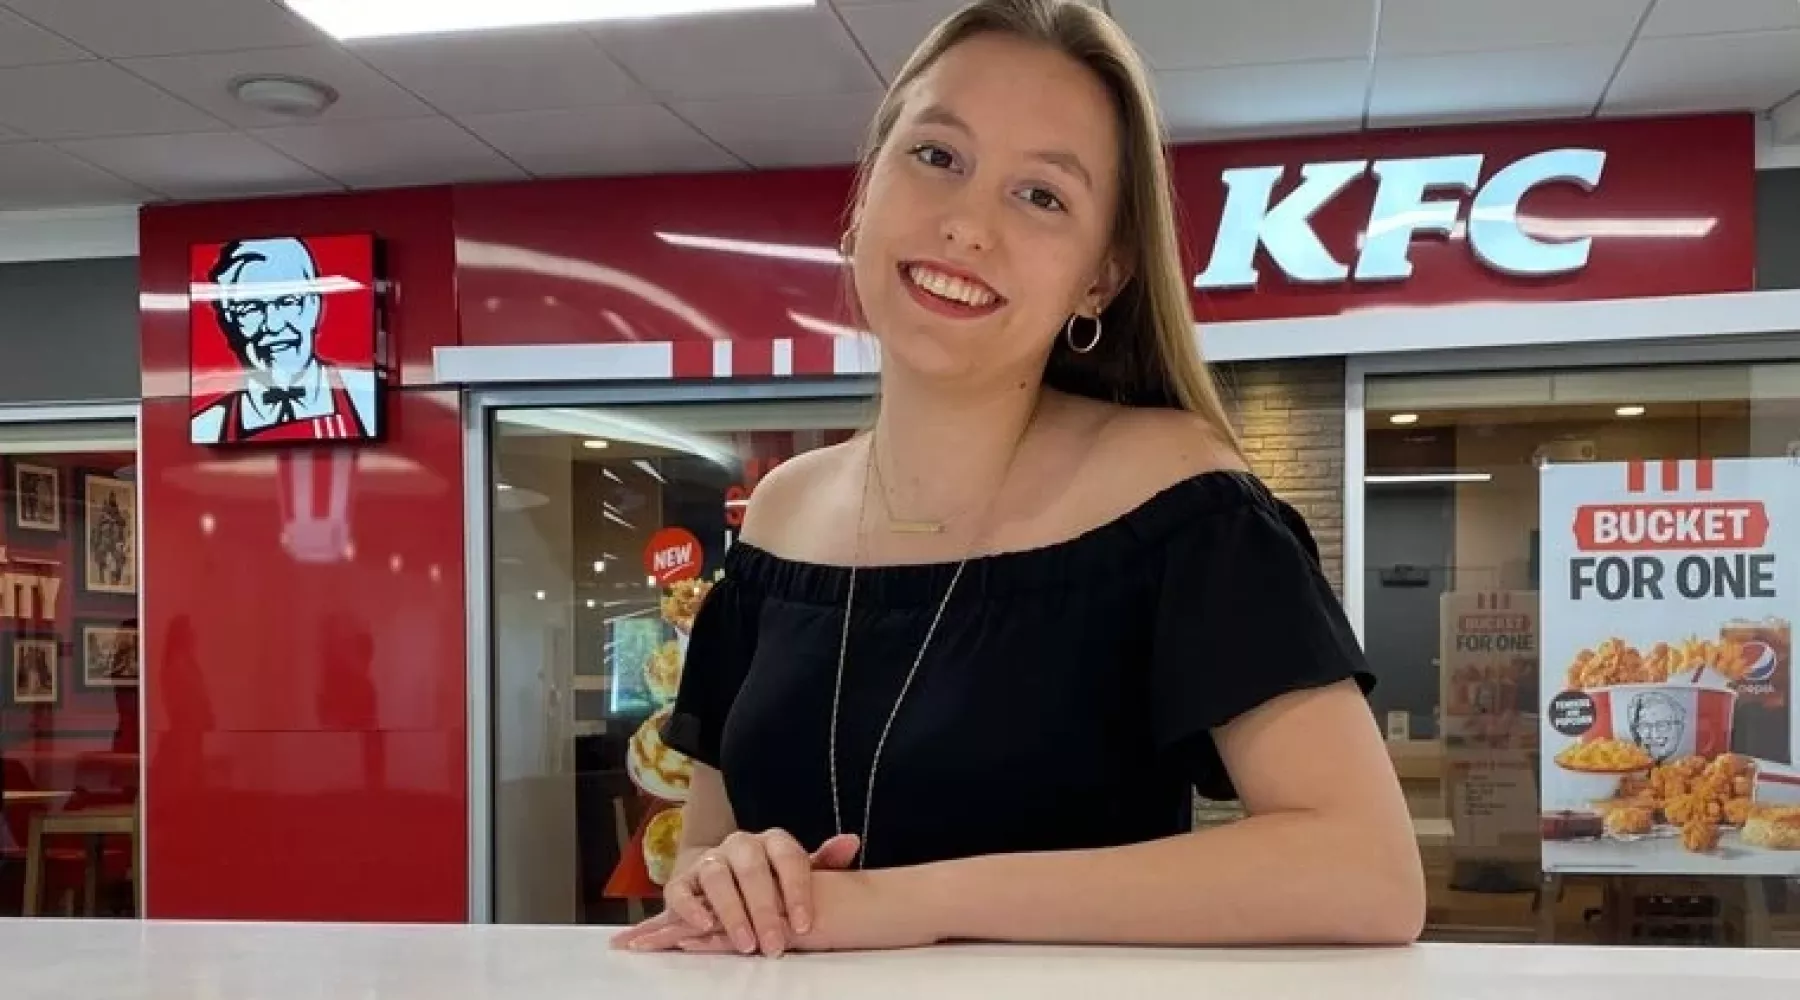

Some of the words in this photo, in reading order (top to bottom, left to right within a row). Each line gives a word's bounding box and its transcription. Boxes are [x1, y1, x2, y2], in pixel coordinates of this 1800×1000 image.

[1193, 148, 1606, 287] KFC
[1593, 508, 1750, 544] BUCKET
[653, 542, 693, 572] NEW
[1569, 556, 1665, 600] FOR
[1676, 554, 1777, 599] ONE
[1456, 634, 1490, 652] FOR
[1497, 634, 1533, 652] ONE
